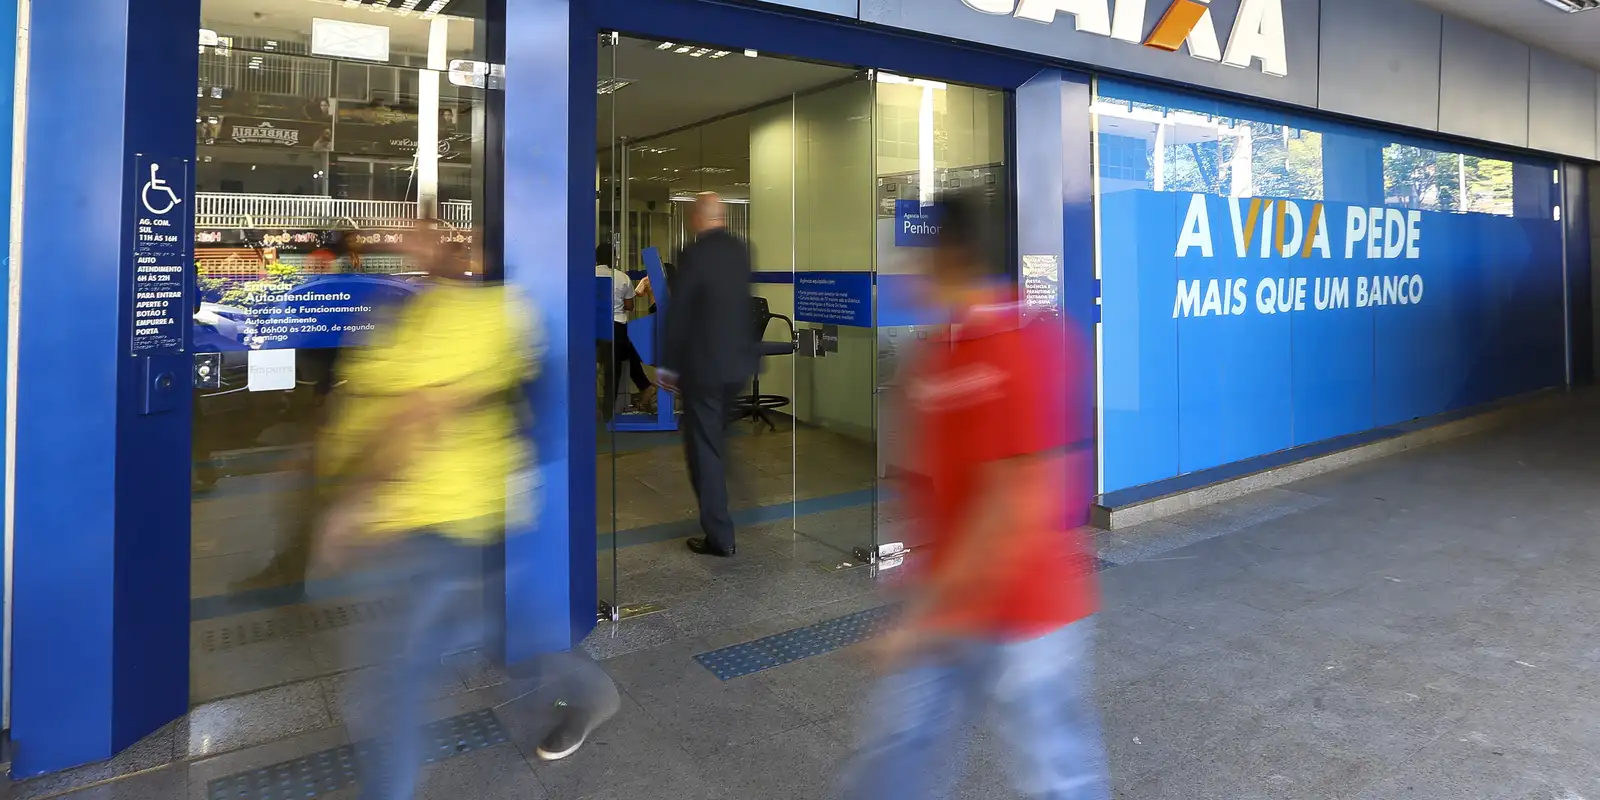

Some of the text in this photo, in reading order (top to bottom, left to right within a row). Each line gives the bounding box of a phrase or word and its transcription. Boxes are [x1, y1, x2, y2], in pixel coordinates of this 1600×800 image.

[153, 219, 171, 227] COM.
[904, 220, 942, 235] Penhor
[1174, 193, 1421, 258] A VIDA PEDE
[137, 274, 147, 282] 6H
[244, 281, 292, 291] Entrada
[245, 292, 351, 302] Autoatendimento
[1172, 274, 1423, 319] MAIS QUE UM BANCO
[136, 308, 161, 317] BOTÃO
[244, 304, 372, 315] Horário de Funcionamento:
[136, 318, 167, 326] EMPURRE
[244, 316, 317, 325] Autoatendimento
[243, 326, 258, 334] das
[261, 325, 288, 333] 06h00
[301, 325, 329, 333] 22h00,
[343, 323, 375, 332] segunda
[251, 334, 288, 342] domingo
